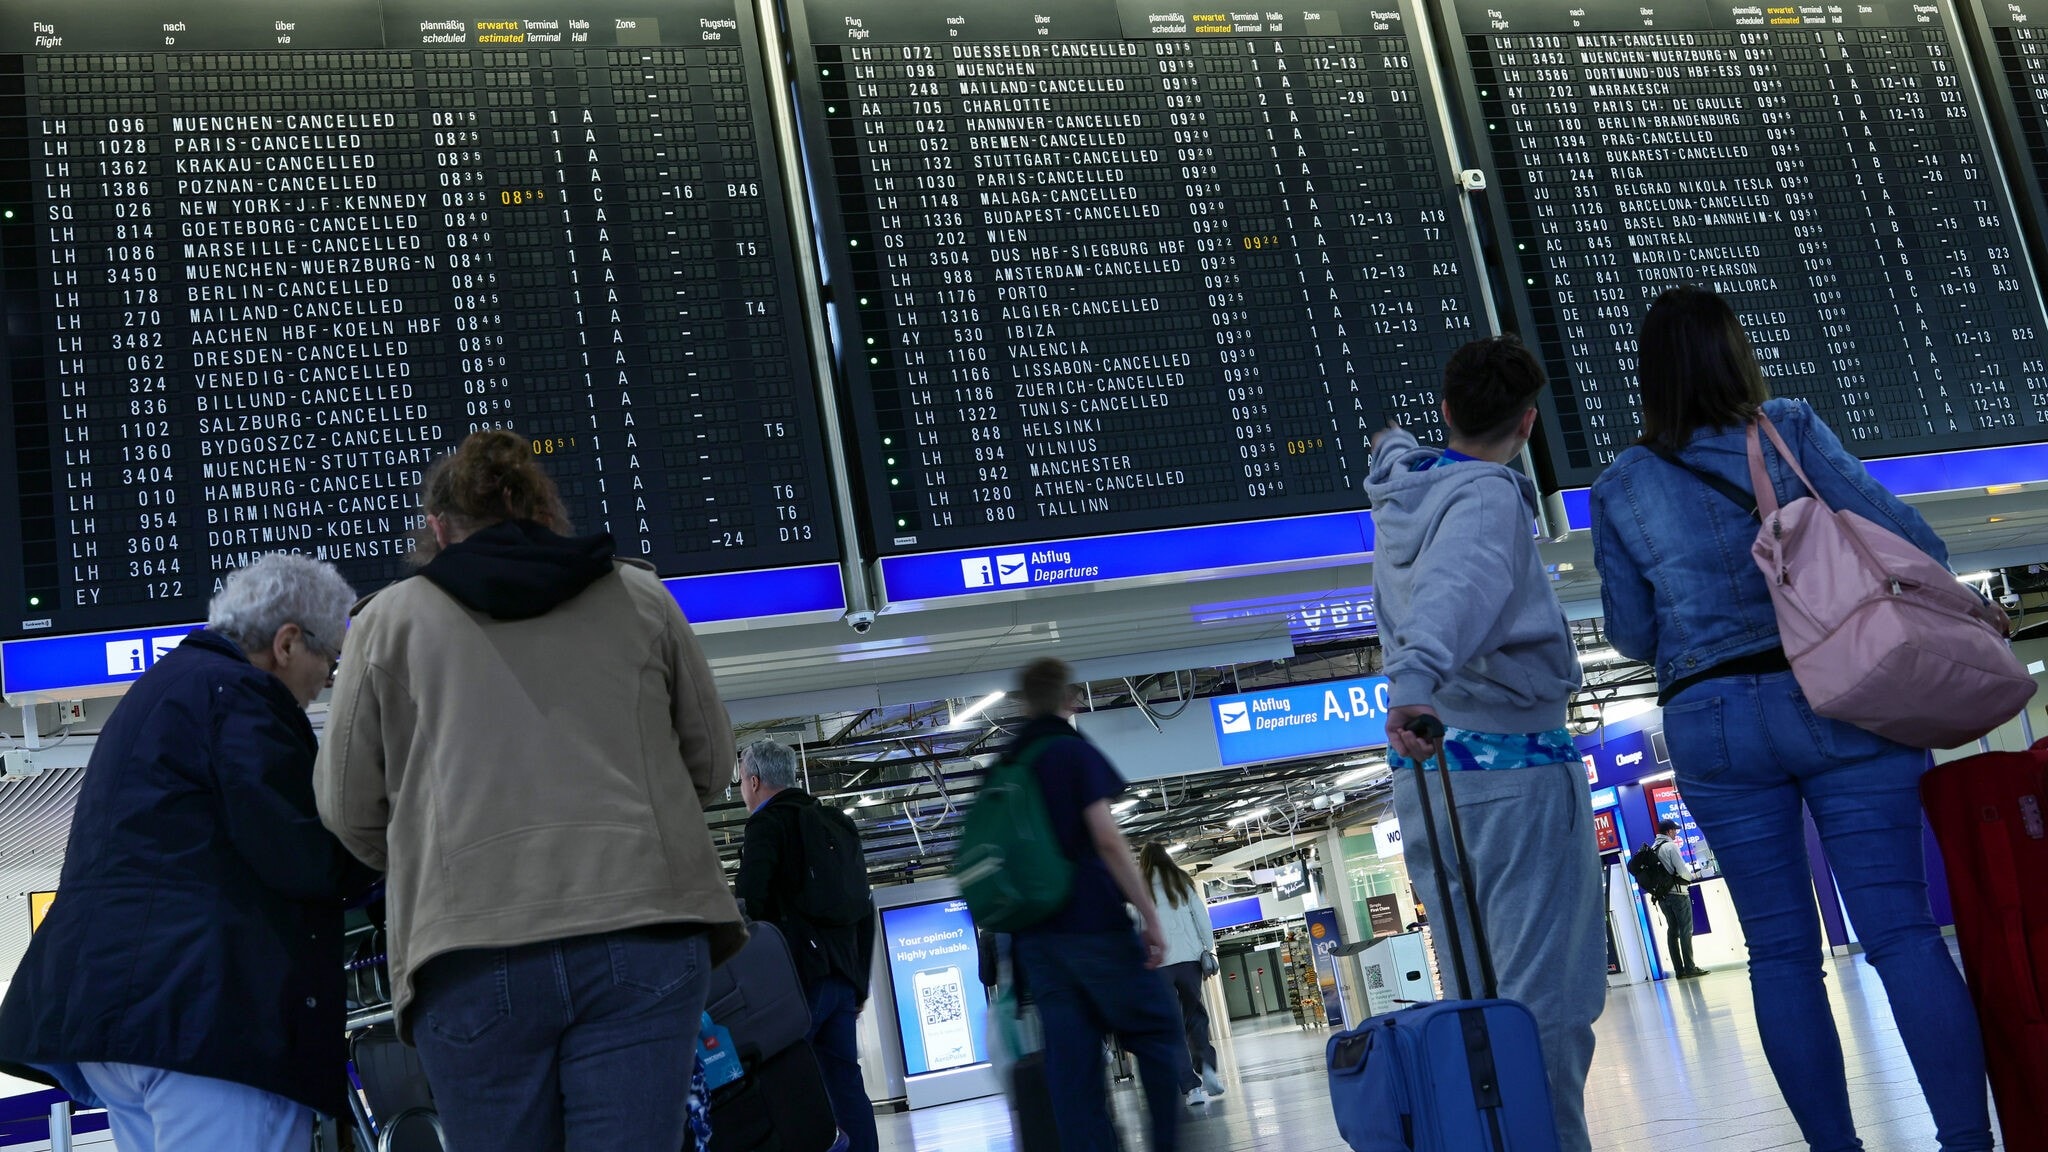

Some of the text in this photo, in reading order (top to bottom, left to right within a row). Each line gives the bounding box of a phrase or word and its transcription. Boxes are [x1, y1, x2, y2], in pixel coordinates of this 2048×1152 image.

[34, 18, 736, 33] Flug nach über planmäßig erwartet Terminal Halle Zone Flugsteig
[846, 11, 1400, 27] Flug nach über planmäßig erwartet Terminal Halle Zone Flugsteig
[36, 31, 720, 46] Flight to via scheduled estimated Terminal Hall Gate
[849, 22, 1388, 39] Flight scheduled estimated Terminal Hall Gate
[1576, 34, 1694, 47] MALTA-CANCELLED
[953, 44, 1136, 58] DUESSELDR-CANCELLED
[1580, 50, 1737, 63] MUENCHEN-WUERZBURG-N
[855, 66, 874, 78] LH
[906, 65, 935, 77] 098
[956, 63, 1035, 76] MUENCHEN
[1252, 59, 1258, 71] 1
[1279, 59, 1286, 70] A
[1314, 57, 1356, 69] 12-13
[1384, 56, 1408, 68] A16
[1585, 65, 1741, 79] DORTMUND-DUS HBF-ESS
[960, 79, 1124, 94] MAILAND-CANCELLED
[1509, 87, 1522, 98] 4Y
[1549, 85, 1573, 97] 202
[1589, 83, 1669, 96] MARRAKESCH
[1851, 78, 1858, 89] A
[1880, 77, 1915, 88] 12-14
[1936, 76, 1956, 87] B27
[963, 98, 1051, 113] CHARLOTTE
[1593, 100, 1633, 112] PARIS
[1673, 99, 1688, 110] DE
[1696, 97, 1742, 110] GAULLE
[43, 120, 66, 134] LH
[109, 118, 144, 133] 096
[173, 113, 394, 131] MUENCHEN-CANCELLED
[966, 114, 1141, 131] HANNNVER-CANCELLED
[1598, 114, 1739, 129] BERLIN-BRANDENBURG
[175, 135, 360, 152] PARIS-CANCELLED
[970, 133, 1125, 149] BREMEN-CANCELLED
[1602, 131, 1713, 145] PRAG-CANCELLED
[974, 150, 1158, 168] STUTTGART-CANCELLED
[1606, 146, 1748, 162] BUKAREST-CANCELLED
[177, 155, 374, 173] KRAKAU-CANCELLED
[1611, 167, 1644, 179] RIGA
[179, 175, 376, 194] POZNAN-CANCELLED
[977, 169, 1123, 186] PARIS-CANCELLED
[980, 187, 1137, 205] MALAGA-CANCELLED
[1615, 178, 1773, 196] BELGRAD NIKOLA TESLA
[49, 205, 73, 220] SQ
[116, 202, 151, 218] 026
[180, 201, 216, 215] NEW
[561, 189, 566, 202] 1
[594, 188, 603, 201] C
[728, 183, 758, 197] B46
[1619, 194, 1769, 212] BARCELONA-CANCELLED
[984, 204, 1160, 224] BUDAPEST-CANCELLED
[1624, 211, 1782, 229] BASEL BAD-MANNHEIM-K
[182, 215, 417, 237] GOETEBORG-CANCELLED
[987, 229, 1027, 243] WIEN
[1628, 232, 1693, 246] MONTREAL
[184, 236, 420, 258] MARSEILLE-CANCELLED
[991, 240, 1185, 262] DUS HBF-SIEGBURG HBF
[1632, 245, 1760, 263] MADRID-CANCELLED
[186, 255, 435, 279] MUENCHEN-WUERZBURG-N
[995, 259, 1180, 281] AMSTERDAM-CANCELLED
[1637, 263, 1757, 280] TORONTO-PEARSON
[188, 279, 388, 301] BERLIN-CANCELLED
[998, 285, 1047, 300] PORTO
[1714, 278, 1777, 293] MALLORCA
[190, 299, 402, 323] MAILAND-CANCELLED
[1003, 298, 1159, 319] ALGIER-CANCELLED
[192, 318, 440, 345] AACHEN HBF-KOELN HBF
[1008, 324, 1055, 339] IBIZA
[194, 341, 407, 367] DRESDEN-CANCELLED
[1008, 341, 1089, 358] VALENCIA
[1013, 353, 1190, 378] LISSABON-CANCELLED
[195, 363, 409, 389] VENEDIG-CANCELLED
[1016, 373, 1184, 397] ZUERICH-CANCELLED
[197, 384, 412, 411] BILLUND-CANCELLED
[1019, 393, 1168, 417] TUNIS-CANCELLED
[200, 405, 427, 433] SALZBURG-CANCELLED
[1023, 418, 1101, 437] HELSINKI
[202, 425, 441, 456] BYDGOSZCZ-CANCELLED
[1026, 438, 1097, 456] VILNIUS
[1030, 456, 1131, 476] MANCHESTER
[205, 471, 422, 501] HAMBURG-CANCELLED
[1035, 471, 1184, 496] ATHEN-CANCELLED
[1037, 497, 1108, 516] TALLINN
[209, 518, 389, 546] DORTMUND-KOELN
[1032, 551, 1071, 565] Abflug
[1035, 565, 1098, 582] Departures
[1252, 697, 1290, 713] Abflug
[1257, 710, 1317, 729] Departures
[1616, 751, 1642, 766] Change
[899, 929, 963, 947] Your opinion?
[897, 943, 970, 961] Highly valuable.
